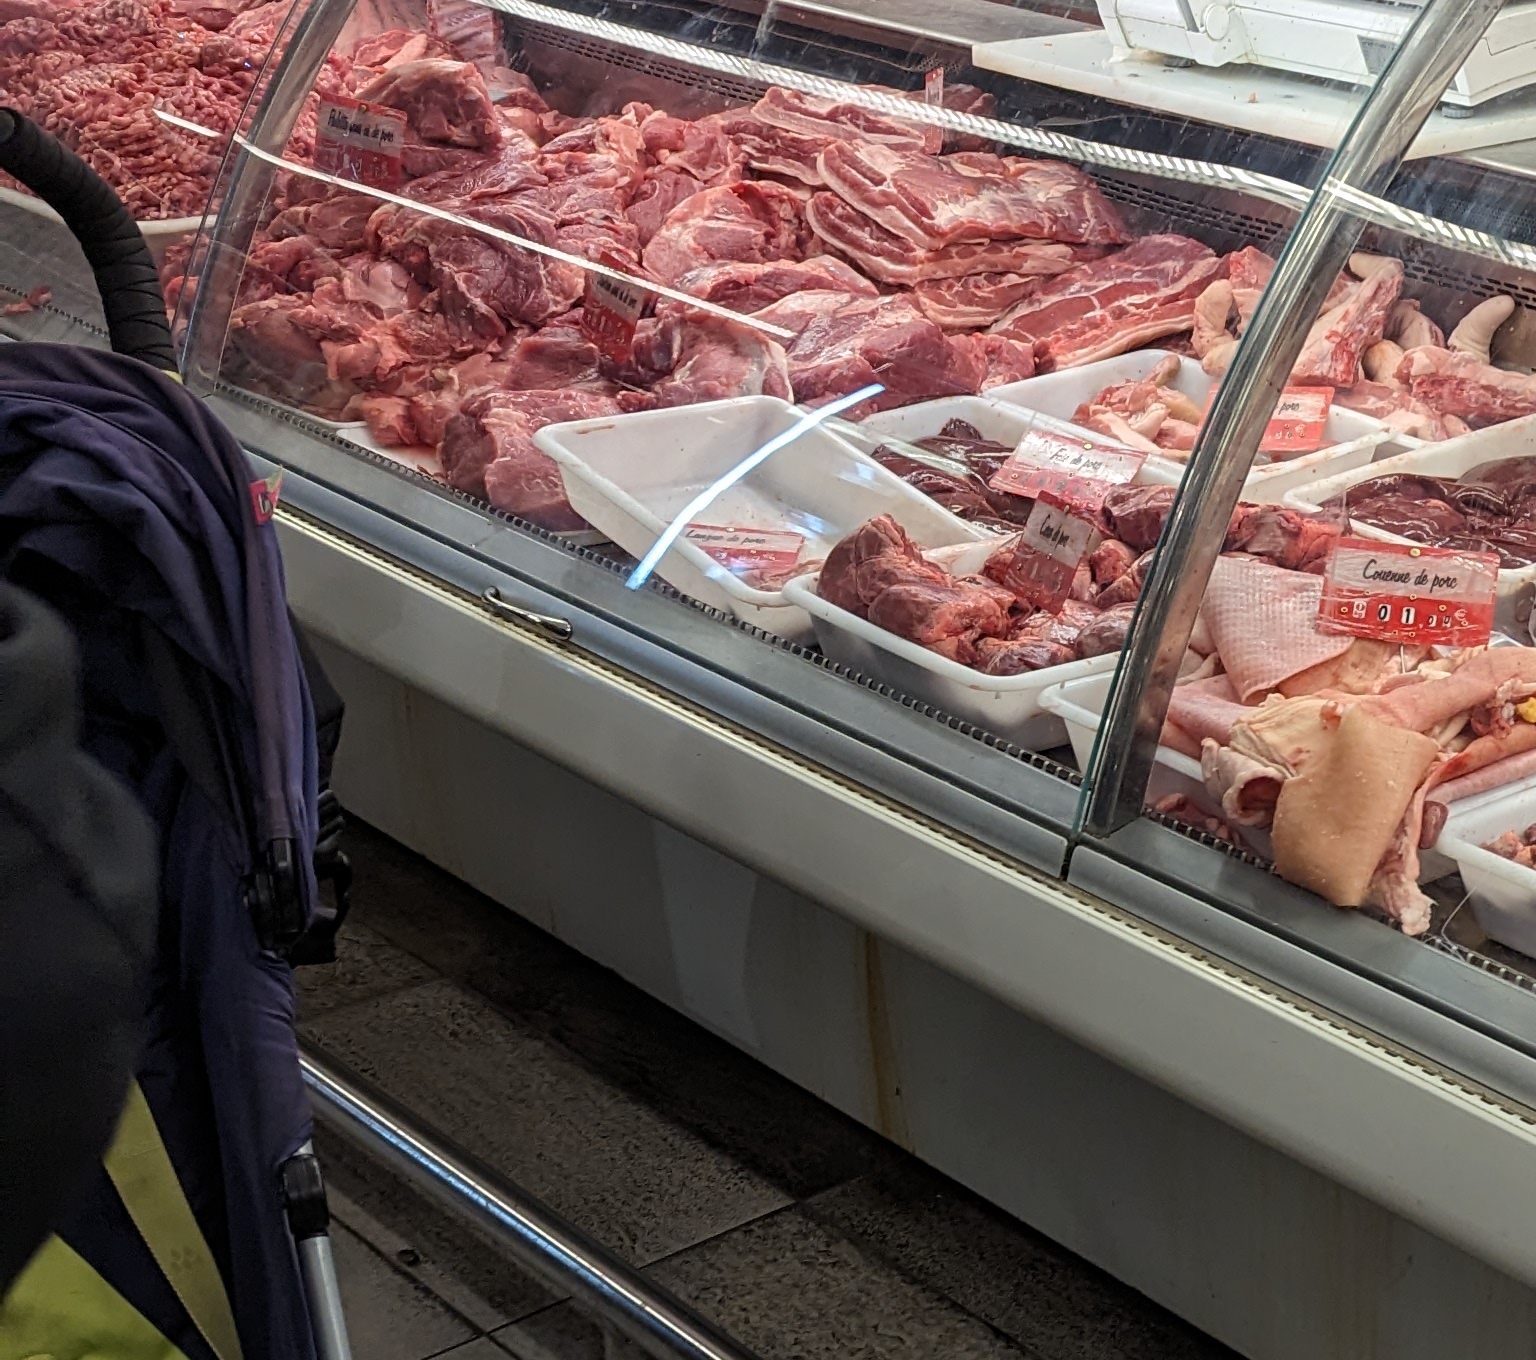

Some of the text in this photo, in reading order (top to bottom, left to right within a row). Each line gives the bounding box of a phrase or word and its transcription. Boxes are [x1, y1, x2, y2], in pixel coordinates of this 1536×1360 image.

[1362, 558, 1458, 593] Couenne de porc
